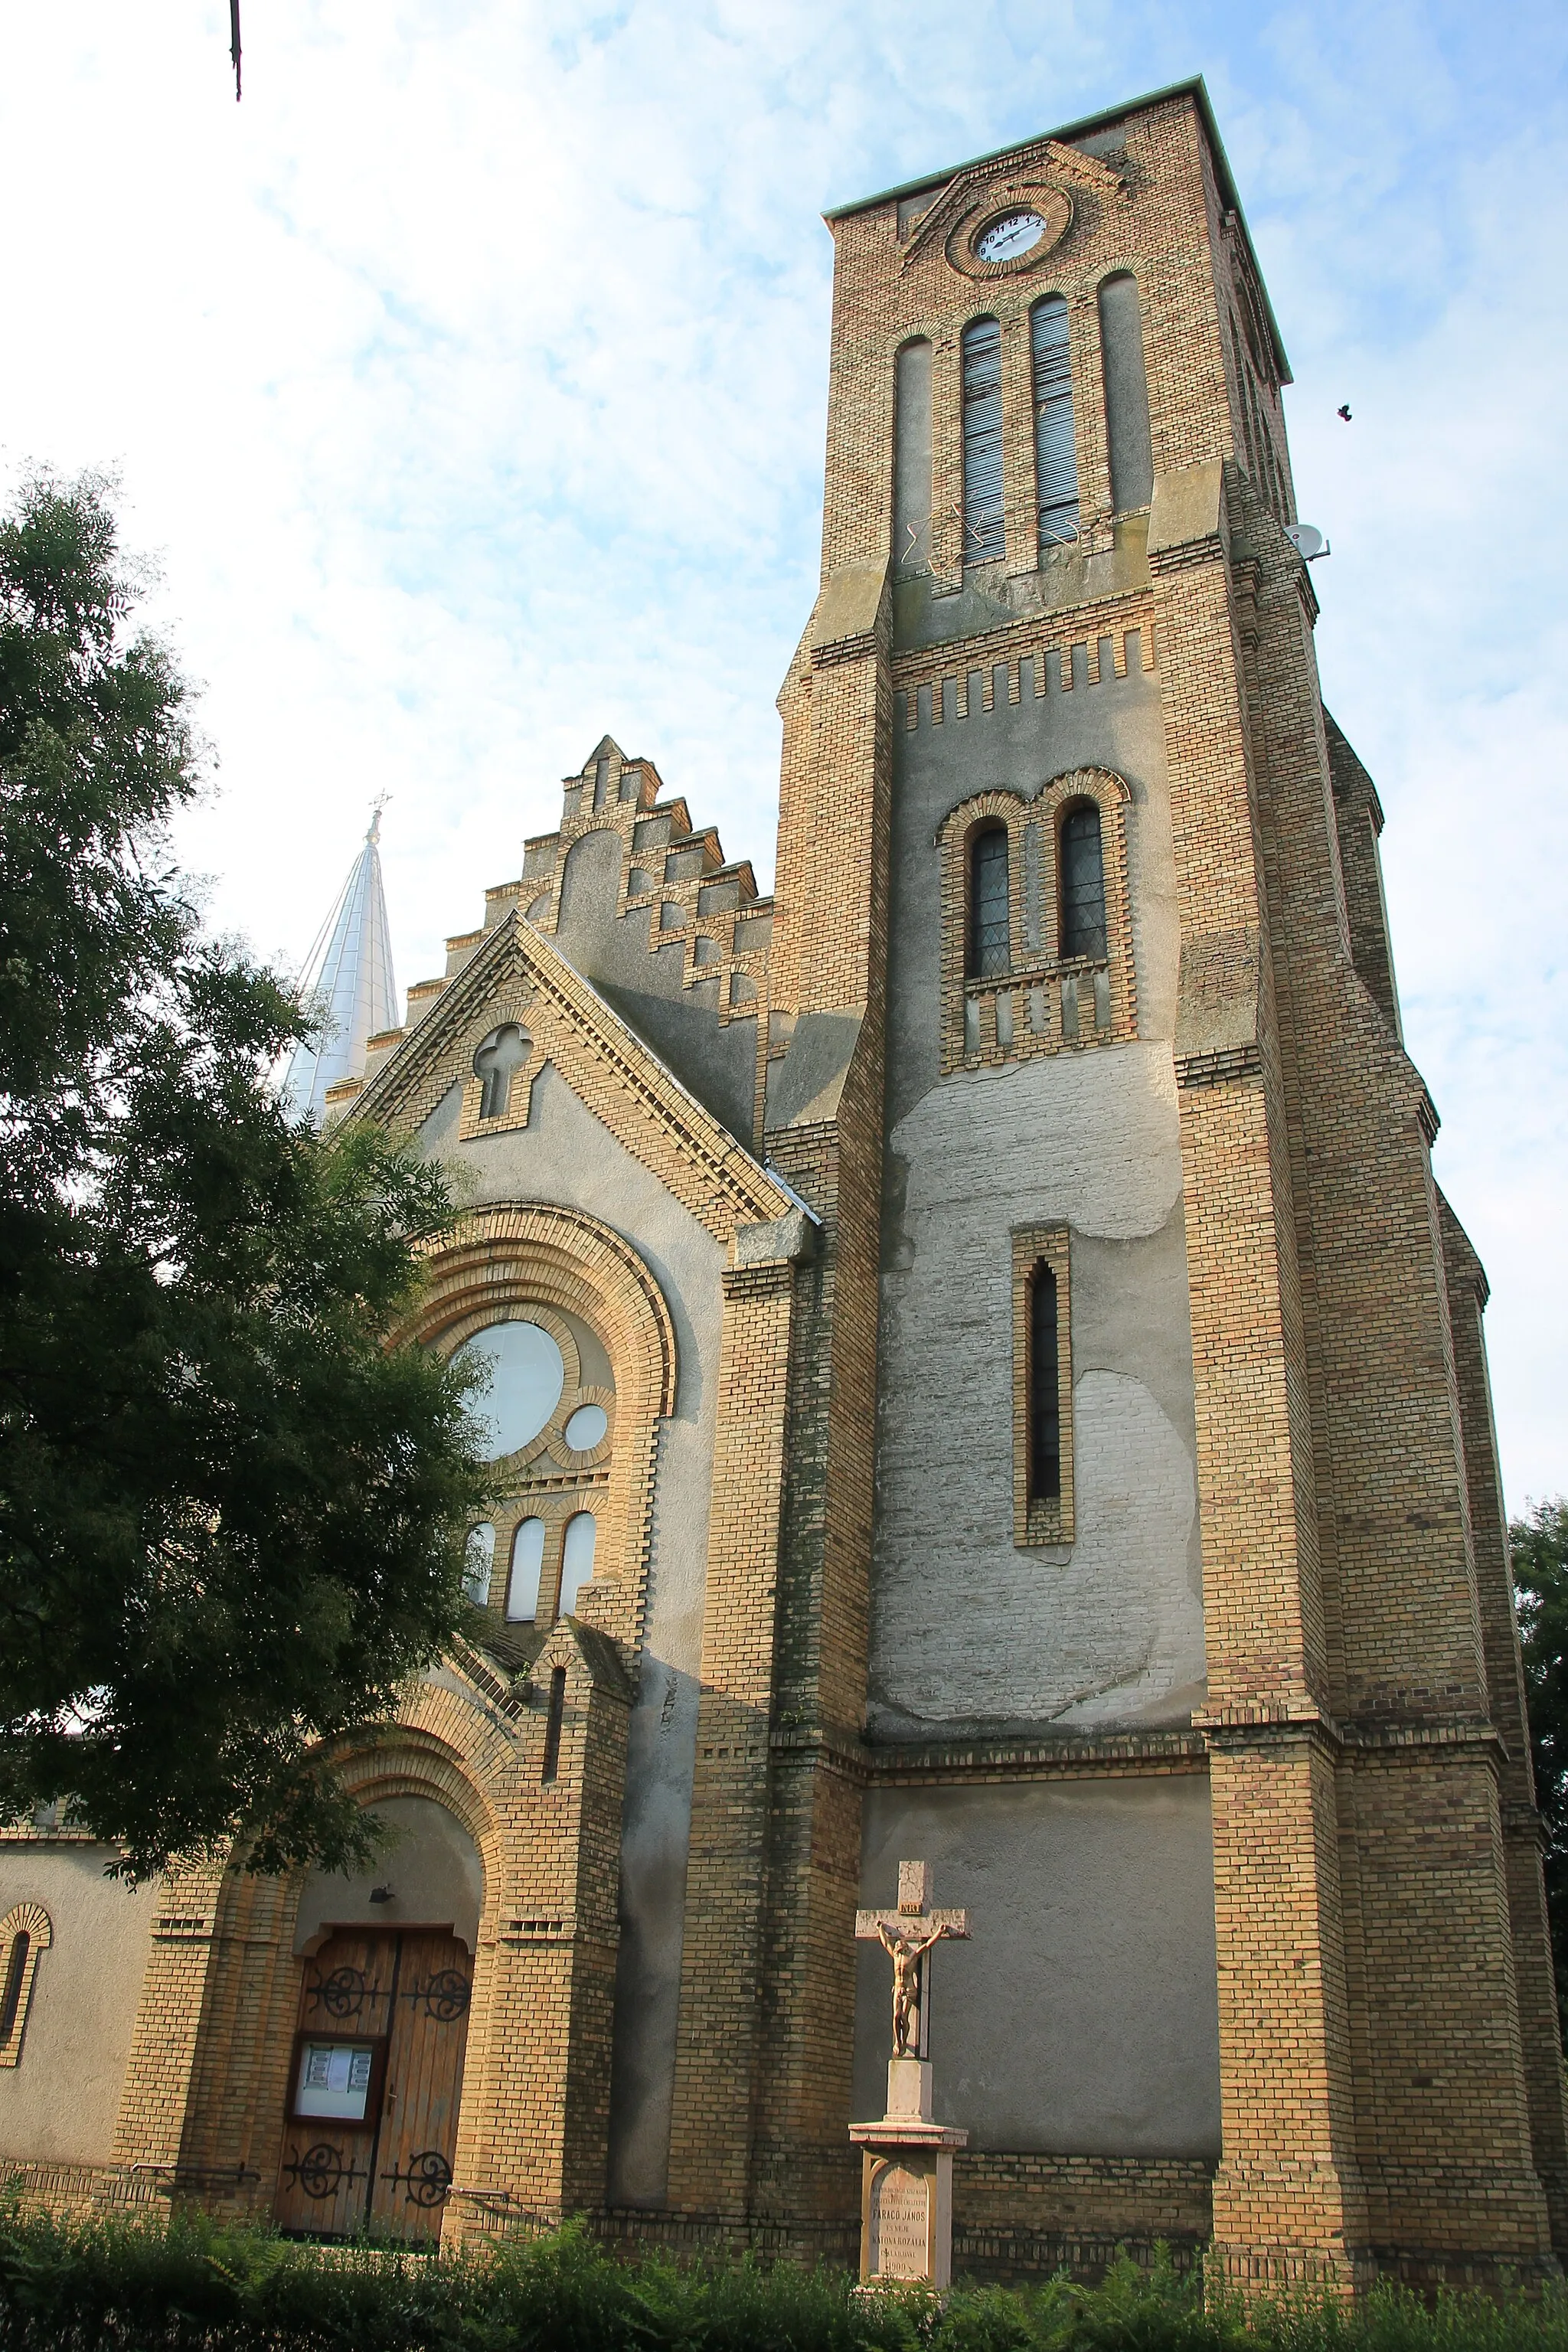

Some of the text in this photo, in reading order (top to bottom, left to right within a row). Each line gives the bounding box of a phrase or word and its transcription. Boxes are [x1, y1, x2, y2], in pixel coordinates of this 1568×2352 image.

[1008, 218, 1018, 227] 12
[995, 225, 1004, 234] 11
[985, 236, 995, 244] 10
[899, 1904, 920, 1913] INRI
